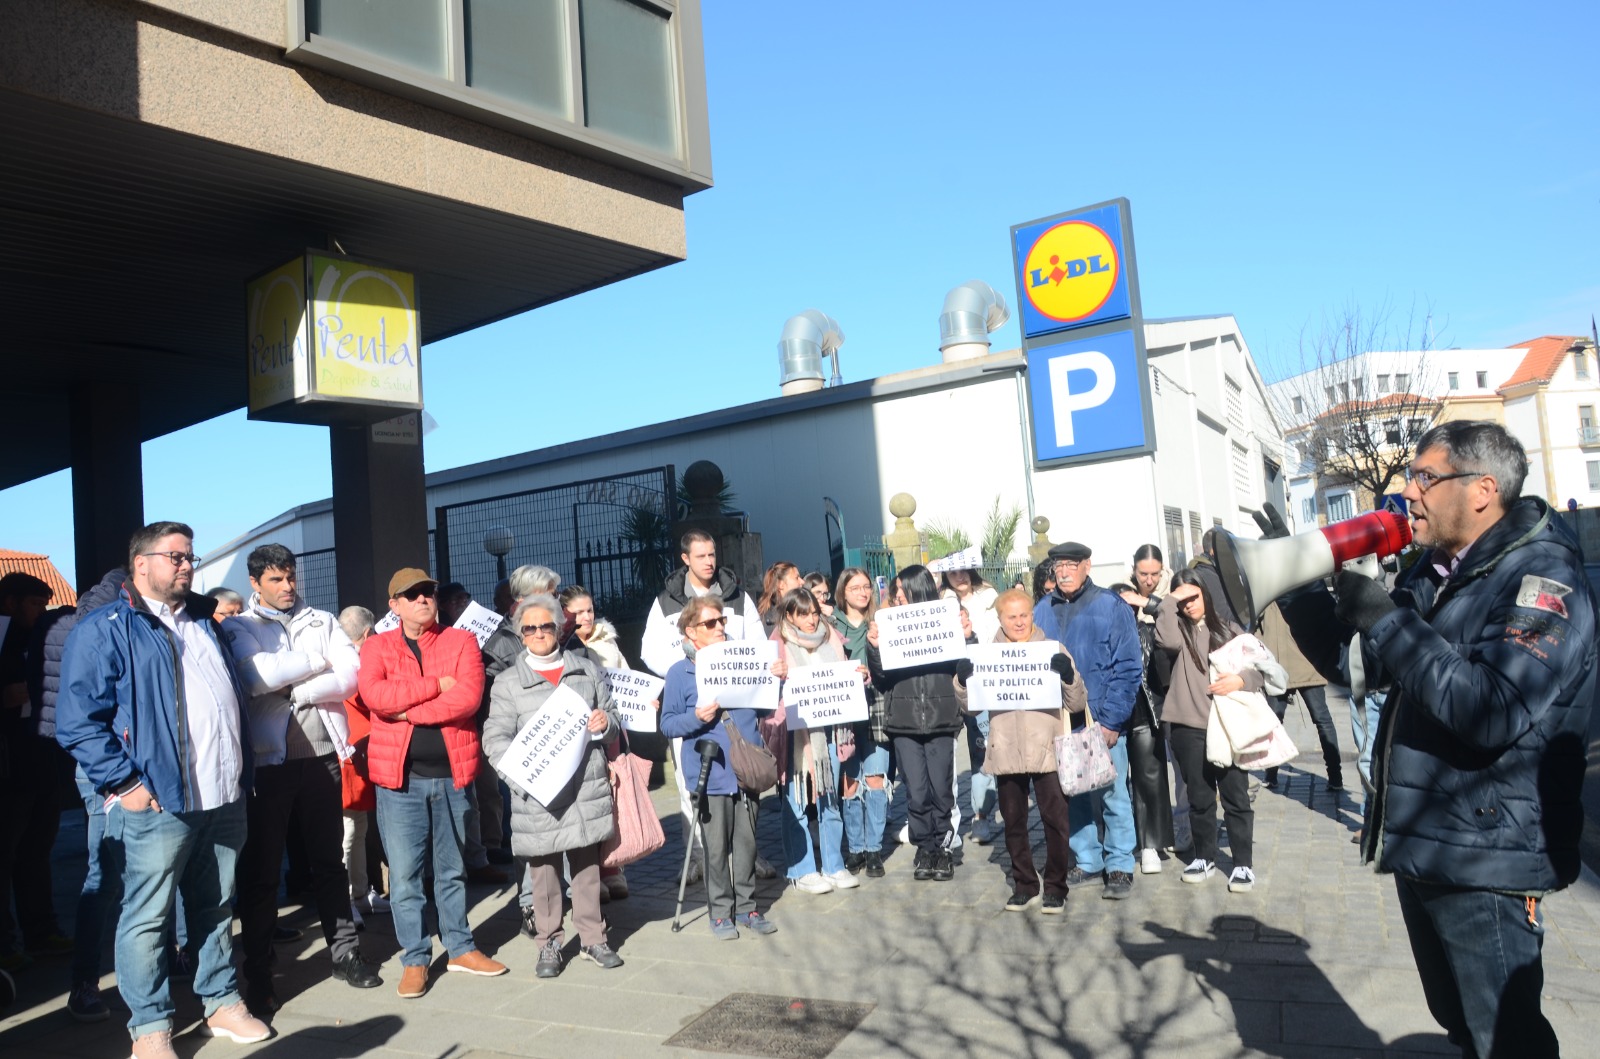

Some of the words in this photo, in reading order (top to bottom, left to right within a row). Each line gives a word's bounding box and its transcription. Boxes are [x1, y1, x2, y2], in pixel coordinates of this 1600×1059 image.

[317, 314, 415, 368] Penta
[1048, 350, 1116, 448] P
[896, 609, 926, 620] MESES
[929, 605, 947, 615] DOS
[897, 619, 942, 633] SERVIZOS
[888, 635, 923, 648] SOCIAIS
[926, 631, 954, 642] BAIXO
[723, 647, 756, 656] MENOS
[710, 661, 760, 671] DISCURSOS
[763, 662, 768, 670] E
[976, 663, 1049, 673] INVESTIMENTO
[634, 677, 651, 688] DOS
[731, 676, 773, 685] RECURSOS
[982, 679, 995, 687] EN
[791, 680, 855, 695] INVESTIMENTO
[996, 692, 1031, 701] SOCIAL
[621, 700, 646, 711] BAIXO
[799, 699, 810, 707] EN
[812, 708, 842, 719] SOCIAL
[521, 713, 551, 746] MENOS
[521, 717, 566, 768] DISCURSOS
[565, 709, 574, 717] E
[549, 713, 590, 758] RECURSOS
